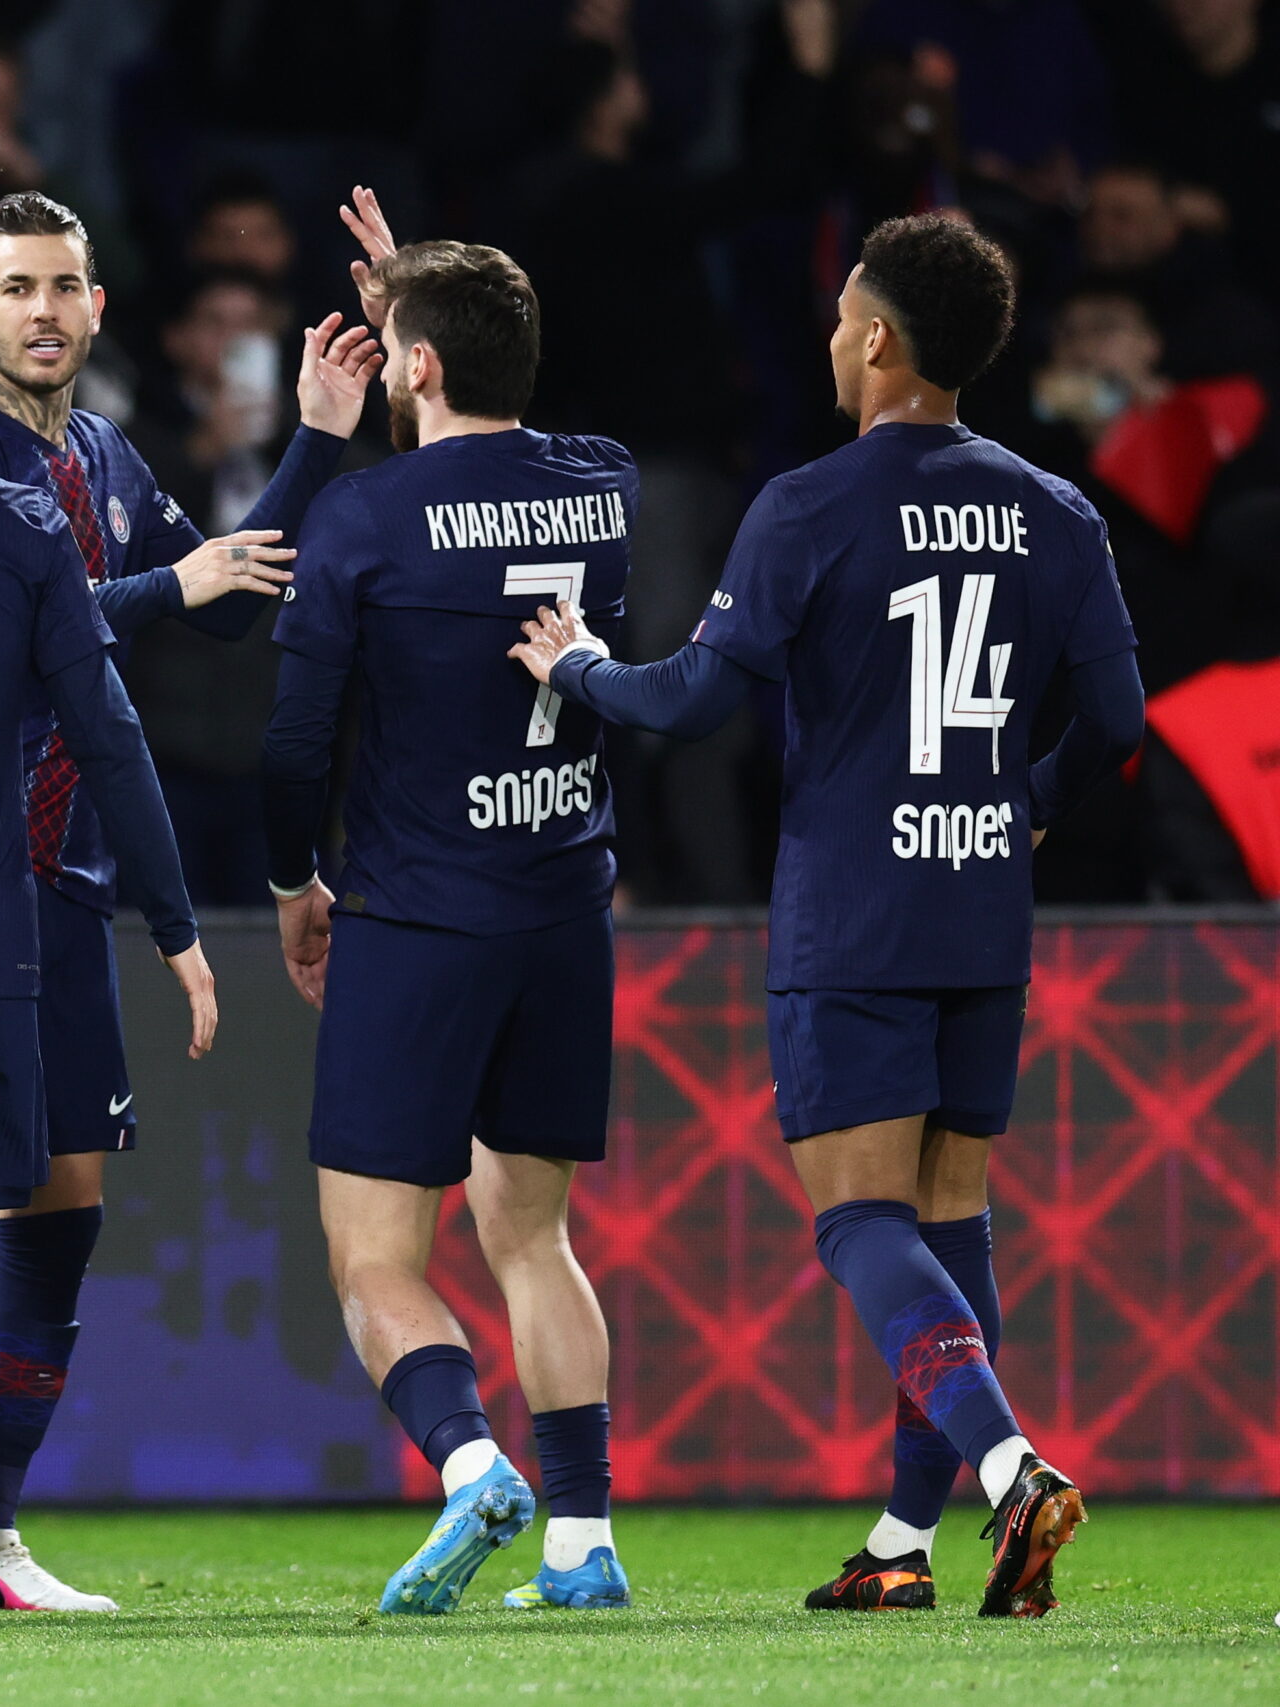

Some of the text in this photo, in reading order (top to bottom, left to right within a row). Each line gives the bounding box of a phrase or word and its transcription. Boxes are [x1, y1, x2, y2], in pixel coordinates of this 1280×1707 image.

[425, 492, 627, 550] KVARATSKHELIA
[900, 503, 1029, 556] D.DOUÉ
[888, 574, 1016, 775] 14
[468, 759, 592, 833] snipes
